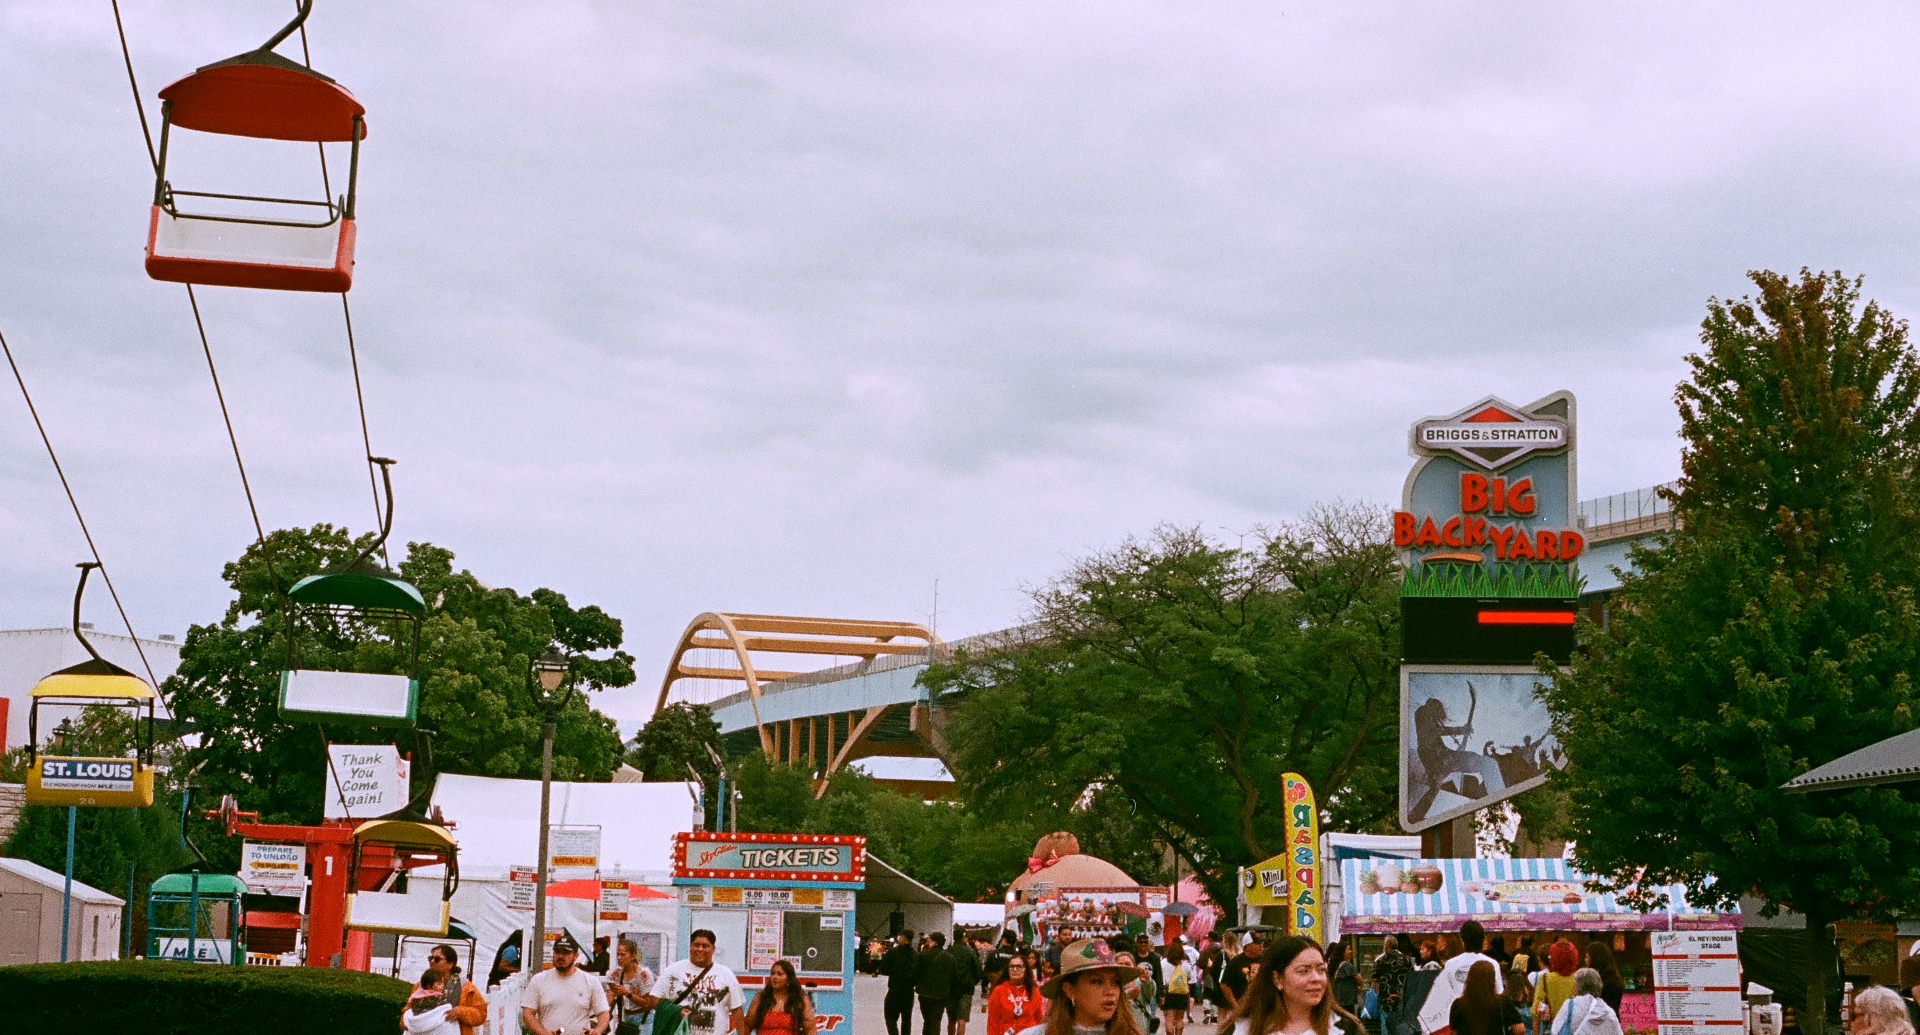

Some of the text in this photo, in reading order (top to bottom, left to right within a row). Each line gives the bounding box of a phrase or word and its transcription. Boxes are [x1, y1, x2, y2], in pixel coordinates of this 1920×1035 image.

[1461, 473, 1535, 513] BIG
[1393, 511, 1584, 560] BACKYARD
[342, 753, 383, 766] Thank
[43, 761, 133, 778] ST. LOUIS
[351, 767, 374, 779] You
[341, 780, 379, 792] Come
[336, 792, 383, 808] Again!
[257, 846, 293, 854] PREPARE
[263, 853, 298, 861] UNLOAD
[554, 857, 594, 865] ENTRANCE
[740, 847, 839, 868] TICKETS
[324, 855, 333, 876] 1
[1261, 870, 1280, 885] Mini
[606, 881, 624, 889] NO
